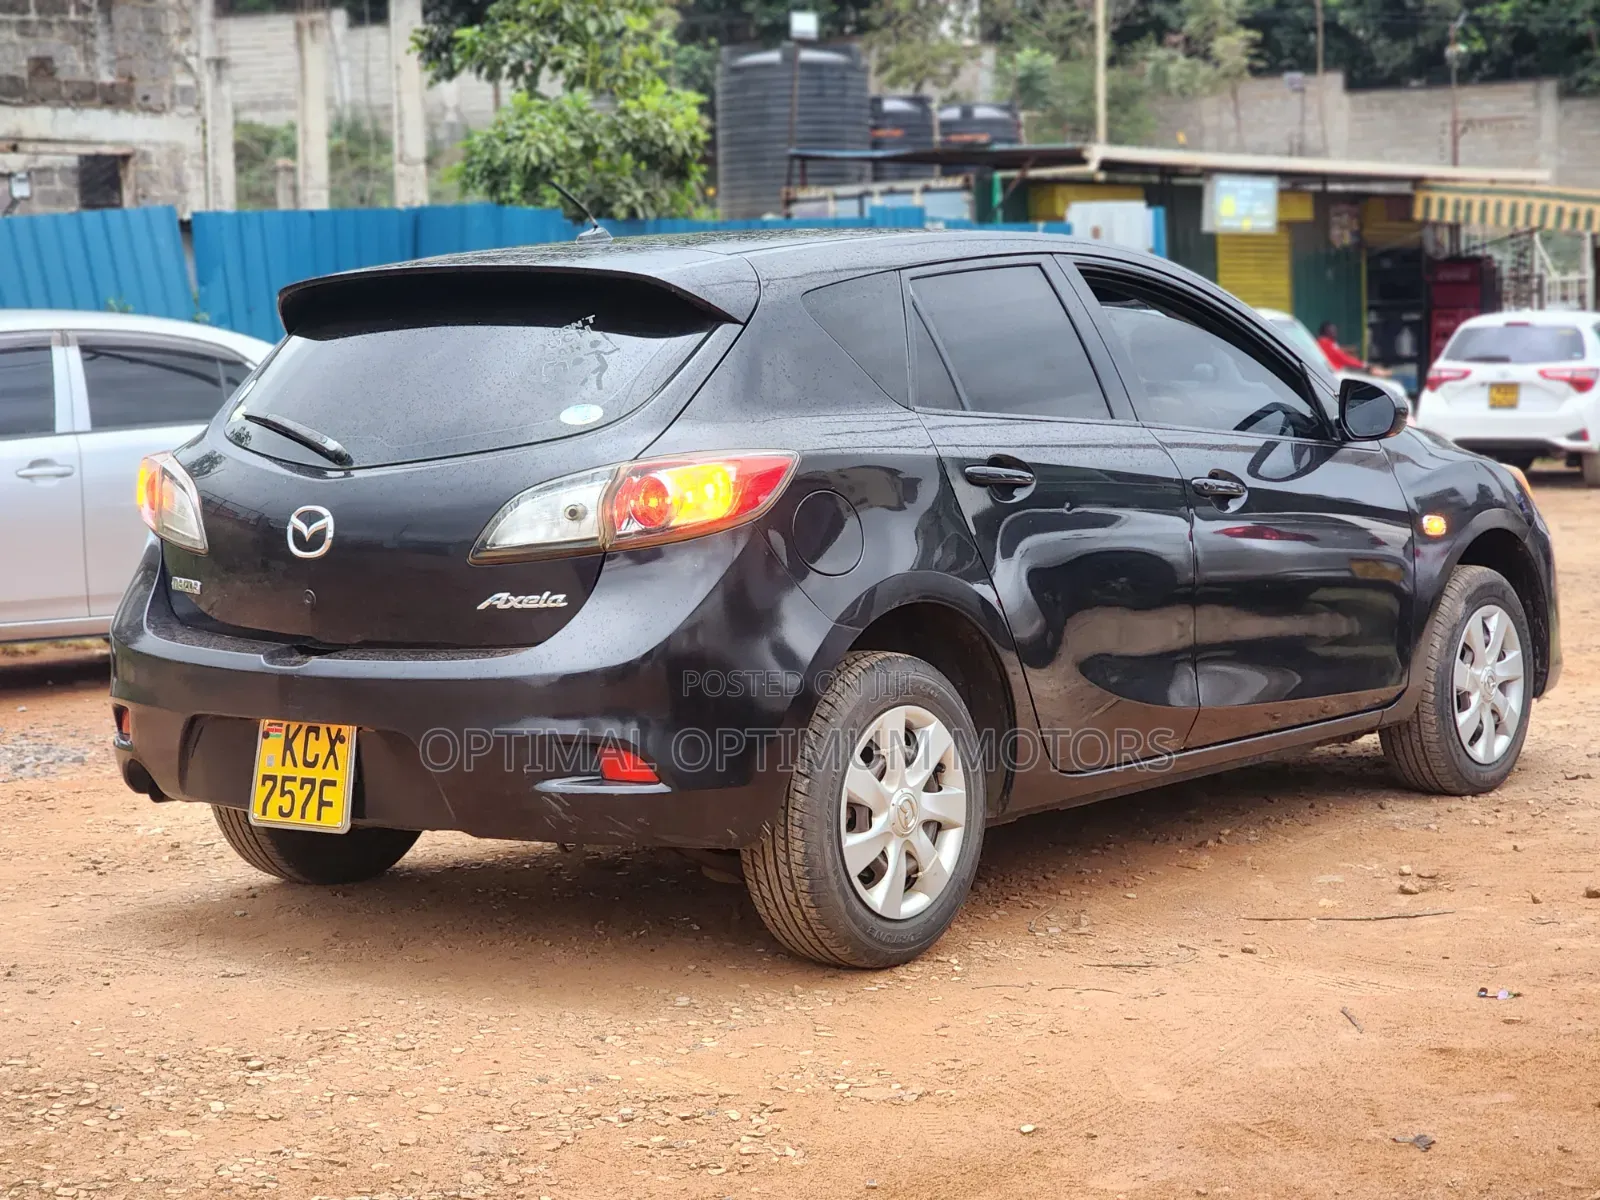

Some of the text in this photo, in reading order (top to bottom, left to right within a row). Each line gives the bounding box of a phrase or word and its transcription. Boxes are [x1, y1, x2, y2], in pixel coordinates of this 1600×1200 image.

[476, 591, 568, 610] Axela
[281, 723, 342, 771] KCX
[261, 774, 337, 821] 757F
